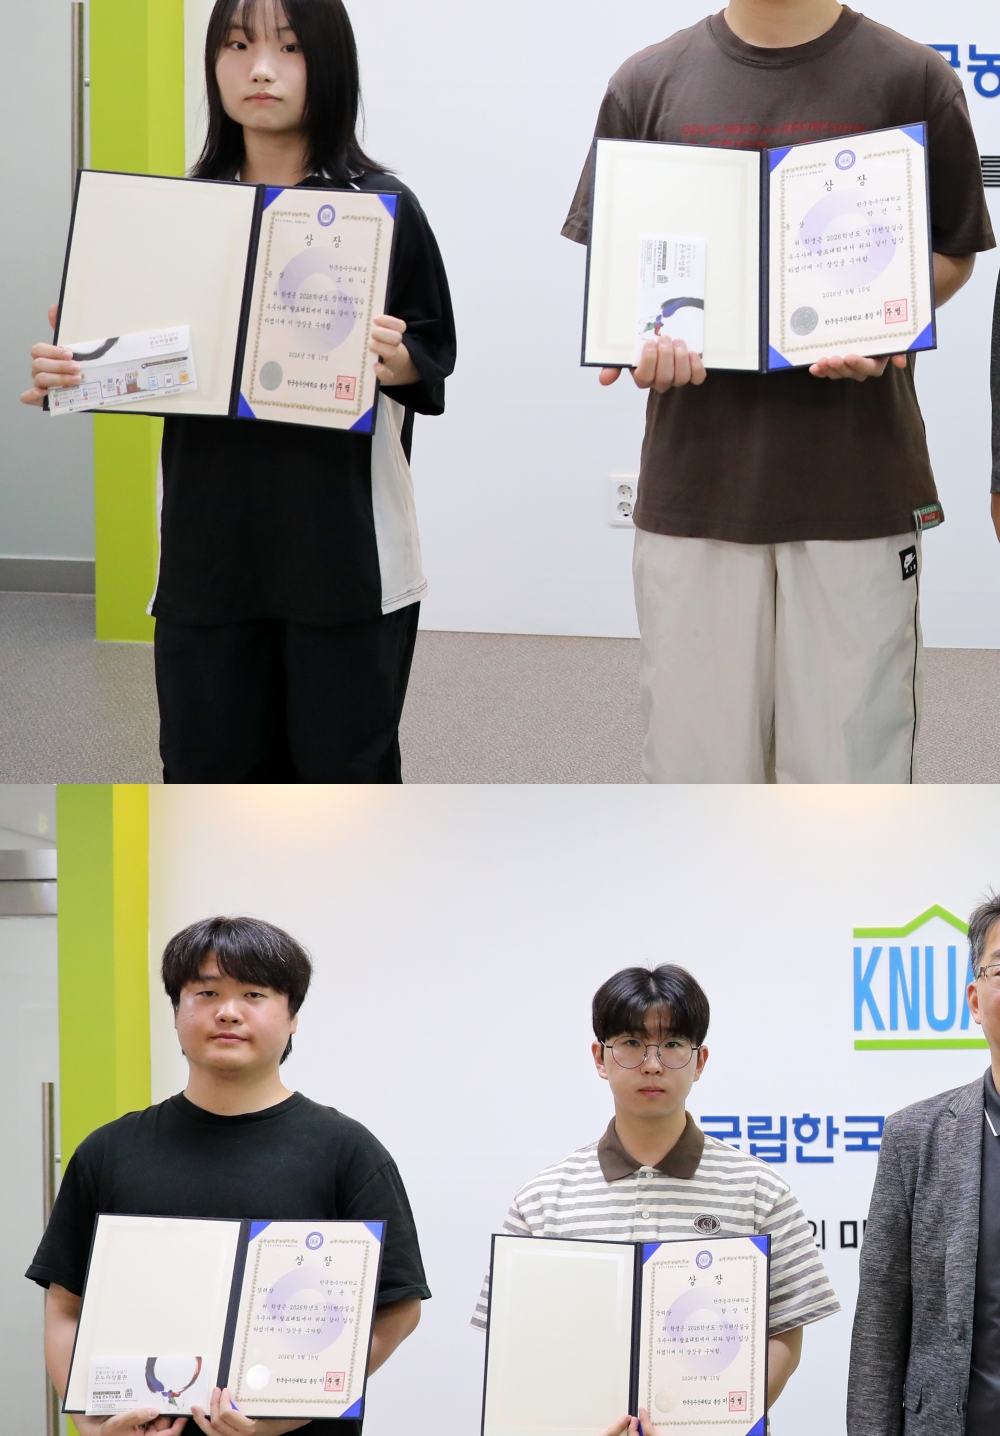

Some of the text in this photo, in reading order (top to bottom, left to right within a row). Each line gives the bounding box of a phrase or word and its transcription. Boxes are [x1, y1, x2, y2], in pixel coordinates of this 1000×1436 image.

[823, 174, 867, 192] 상 장
[304, 234, 341, 248] 상 장
[295, 1256, 332, 1266] 상 장
[688, 1274, 723, 1286] 상 장
